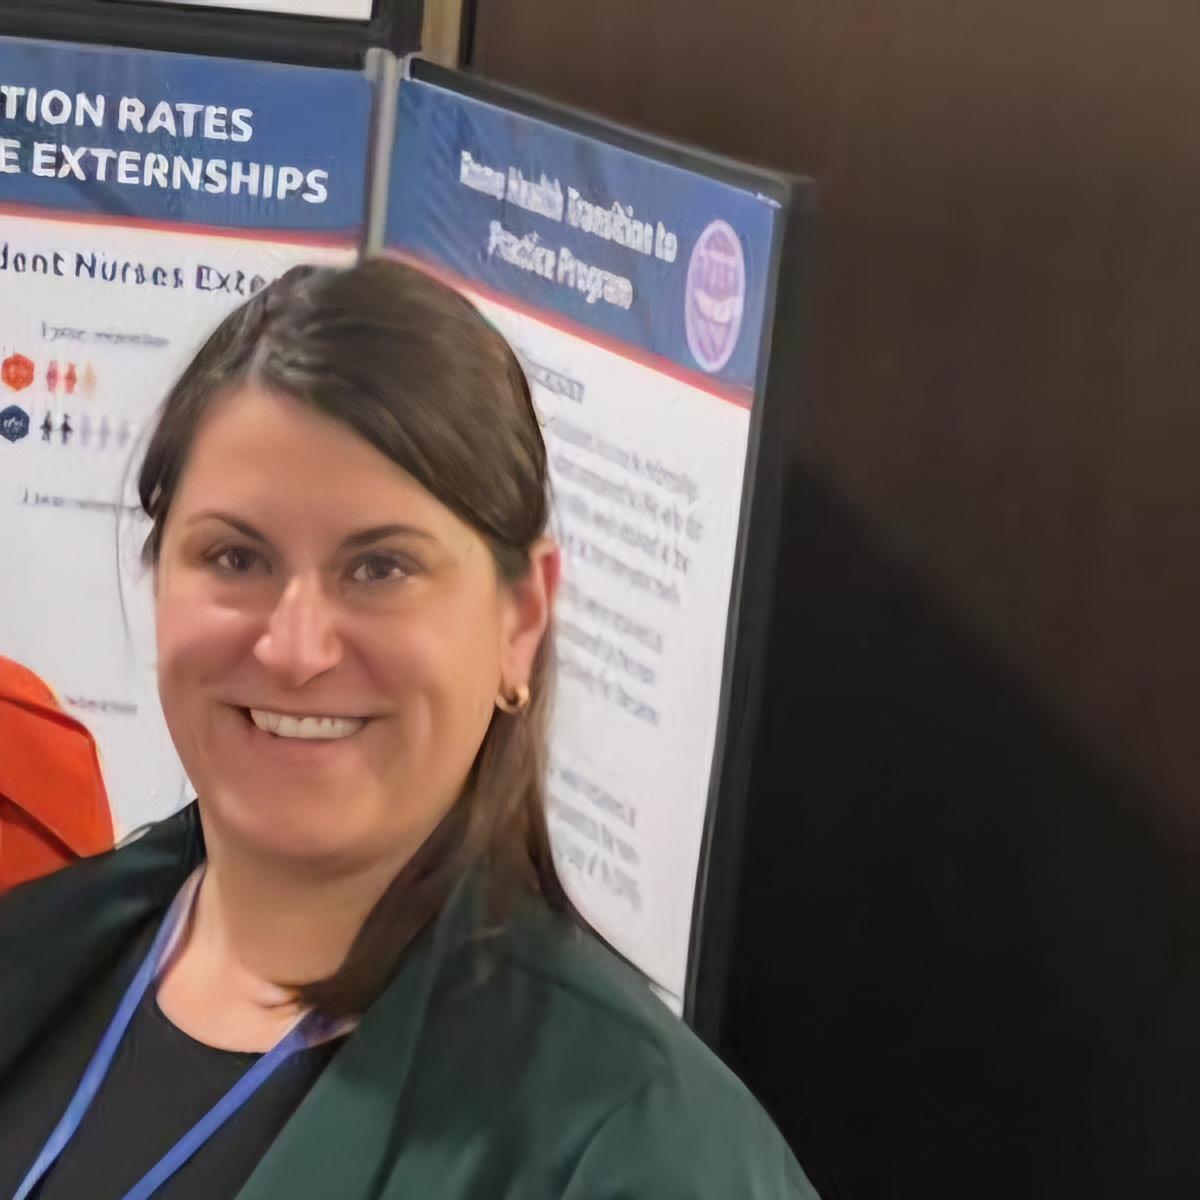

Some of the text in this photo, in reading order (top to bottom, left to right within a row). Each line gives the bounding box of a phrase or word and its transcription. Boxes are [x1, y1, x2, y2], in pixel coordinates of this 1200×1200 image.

[117, 96, 254, 143] RATES
[32, 141, 330, 205] EXTERNSHIPS
[75, 251, 185, 289] Nurses
